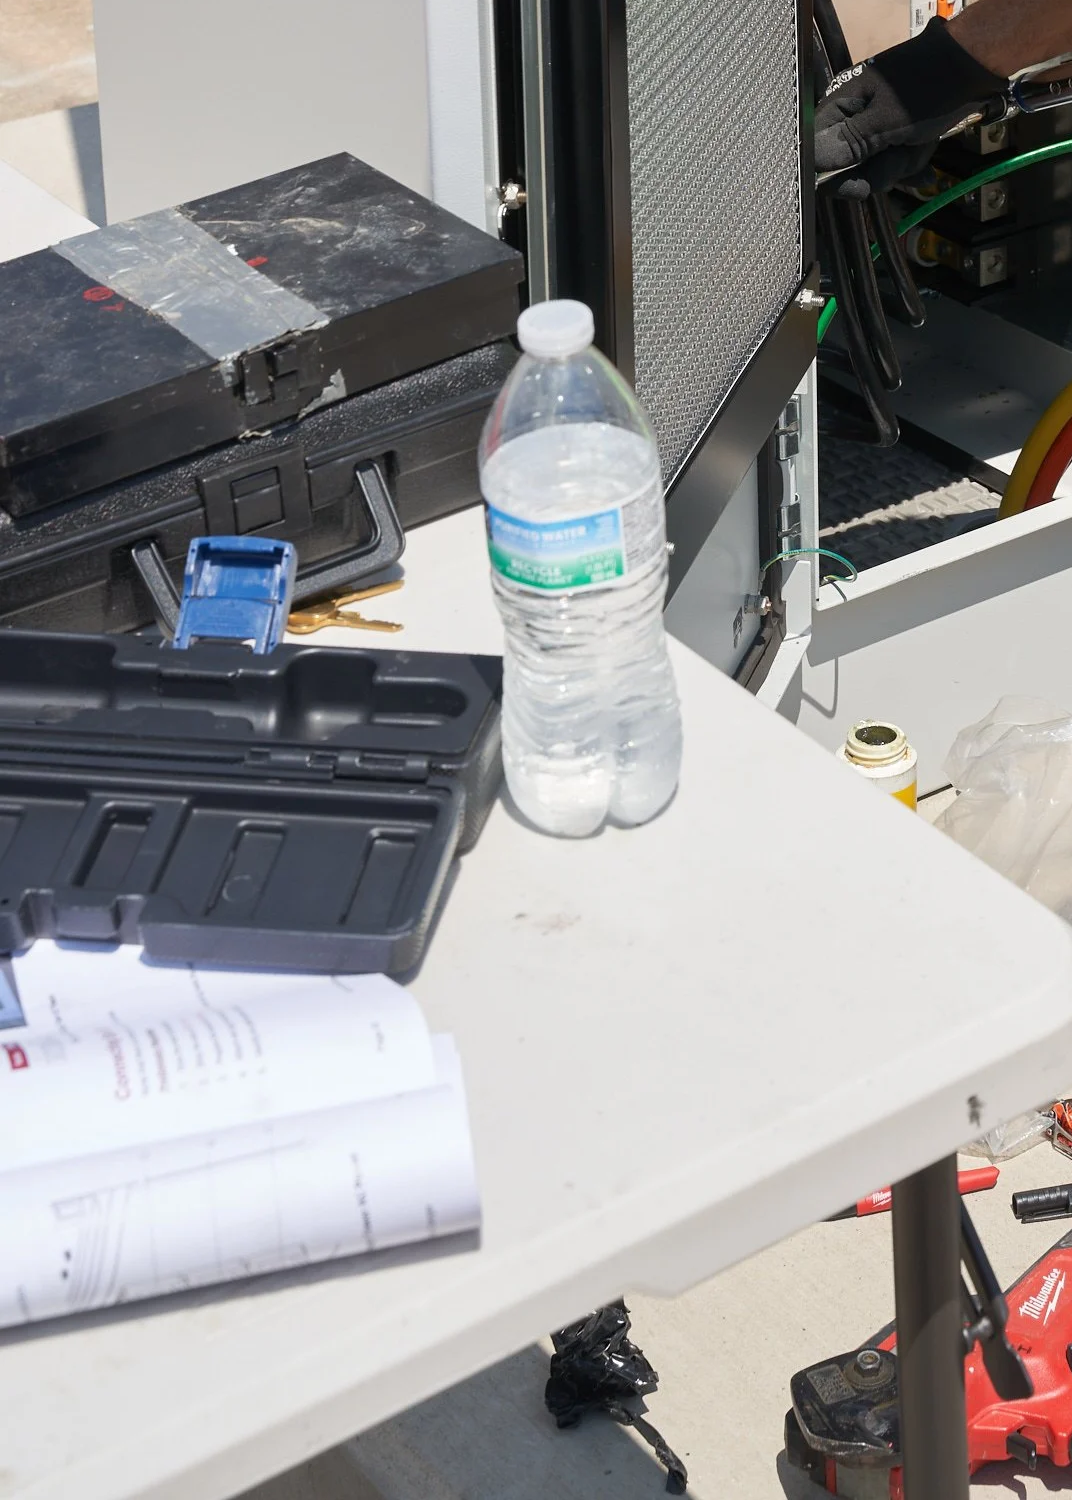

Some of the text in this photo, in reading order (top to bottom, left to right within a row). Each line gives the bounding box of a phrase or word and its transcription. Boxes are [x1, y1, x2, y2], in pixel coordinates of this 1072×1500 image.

[540, 524, 587, 543] WATER
[509, 557, 563, 579] RECYCLE
[1019, 1268, 1061, 1319] Milwaukee
